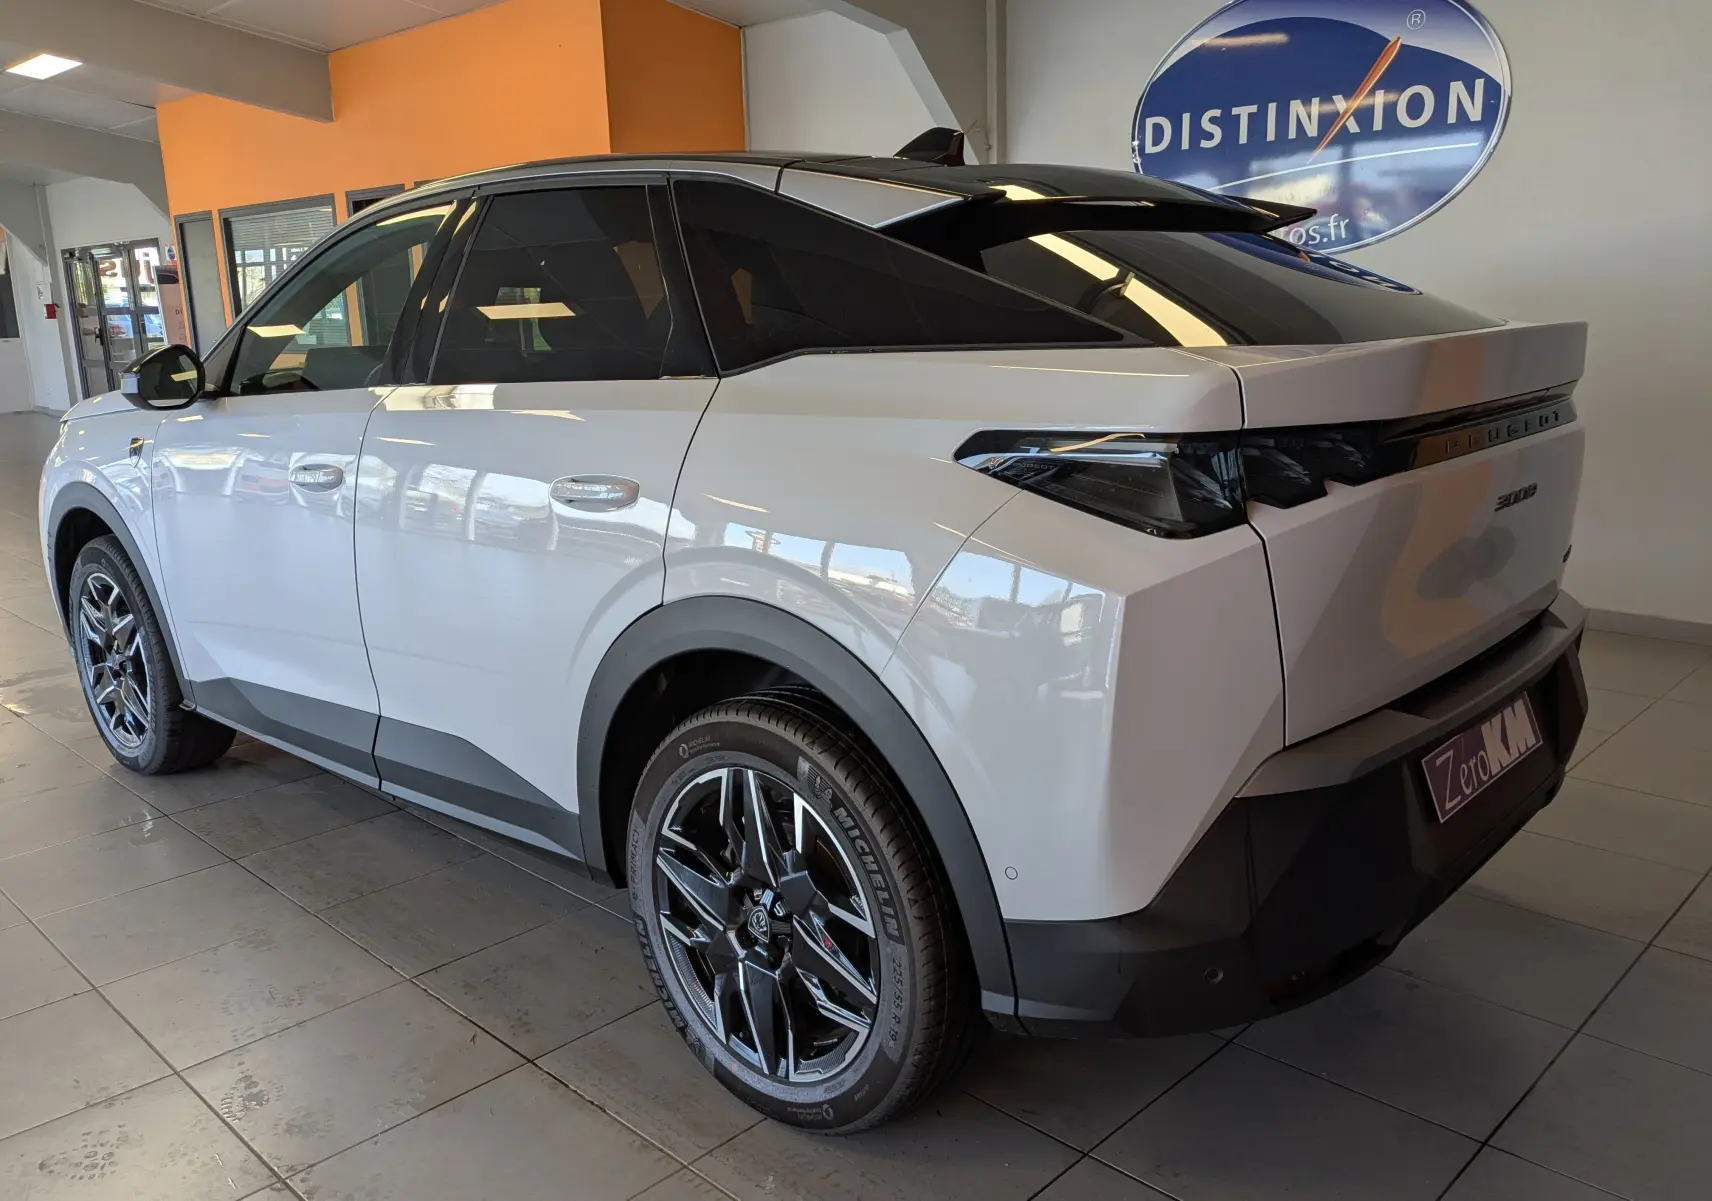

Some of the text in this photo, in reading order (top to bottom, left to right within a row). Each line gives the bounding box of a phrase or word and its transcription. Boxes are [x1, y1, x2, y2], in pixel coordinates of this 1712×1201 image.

[1143, 78, 1485, 155] DISTINXION
[1444, 410, 1562, 454] PEUGEOT
[833, 806, 901, 938] MICHELIN
[635, 914, 684, 1029] MICHELIN
[892, 956, 904, 1011] 225/55
[889, 1026, 899, 1042] 19
